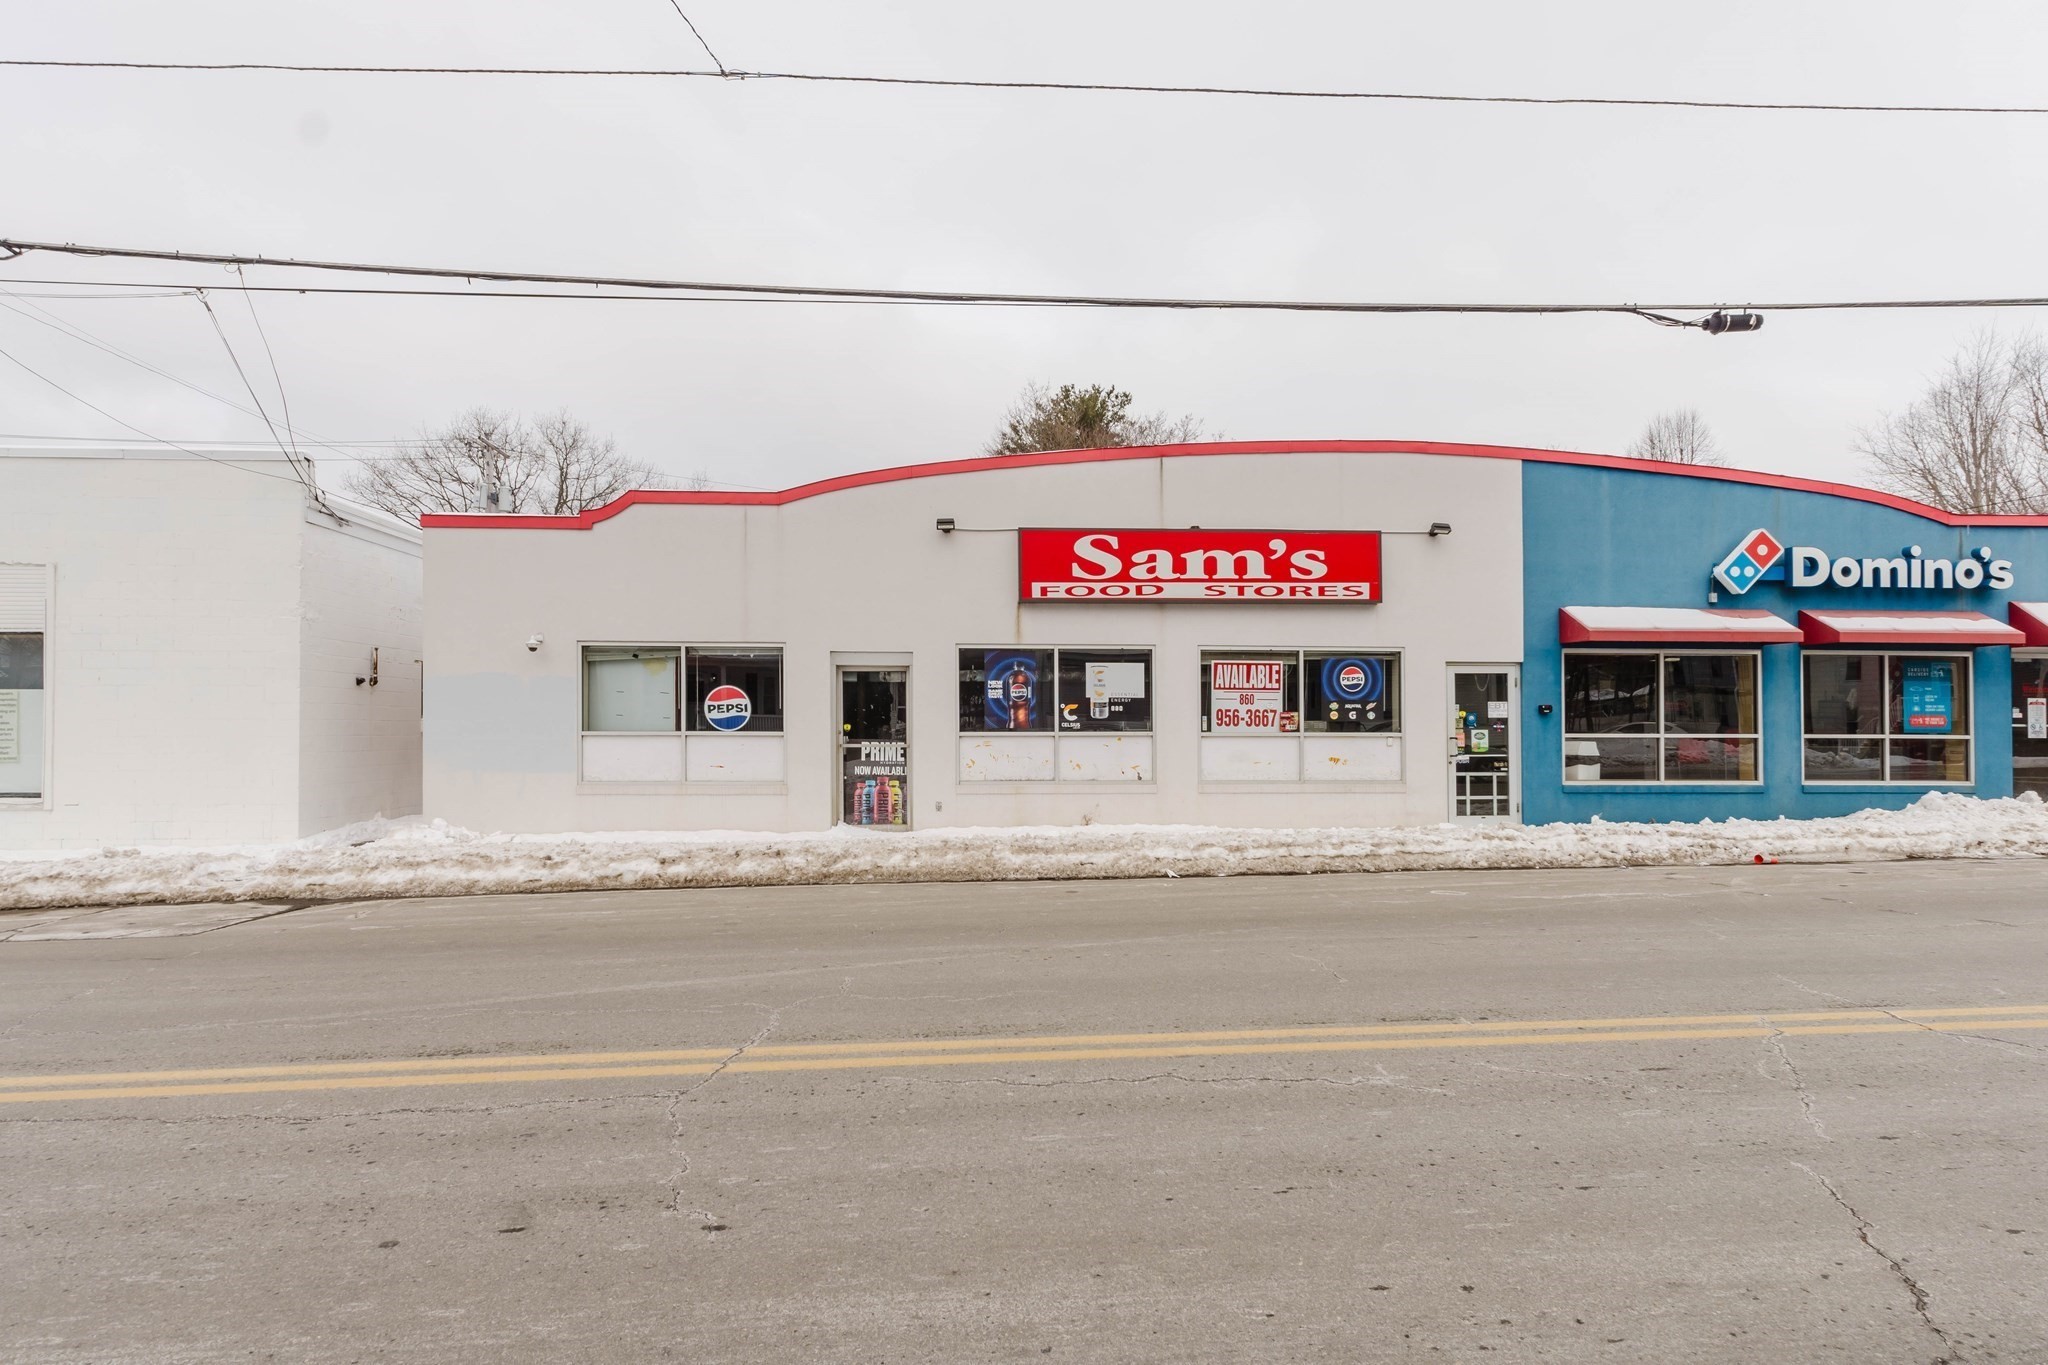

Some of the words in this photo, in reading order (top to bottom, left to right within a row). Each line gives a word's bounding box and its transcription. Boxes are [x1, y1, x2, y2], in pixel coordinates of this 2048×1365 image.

[1071, 534, 1328, 580] Sam's
[1791, 544, 2015, 589] Domino's
[1039, 584, 1164, 597] FOOD
[1204, 585, 1364, 598] STORES
[1215, 663, 1280, 689] AVAILABLE
[707, 703, 748, 714] PEPSI
[1238, 693, 1255, 705] 860
[1215, 708, 1278, 727] 956-3667
[860, 741, 905, 762] PRIME
[854, 765, 871, 775] NOW
